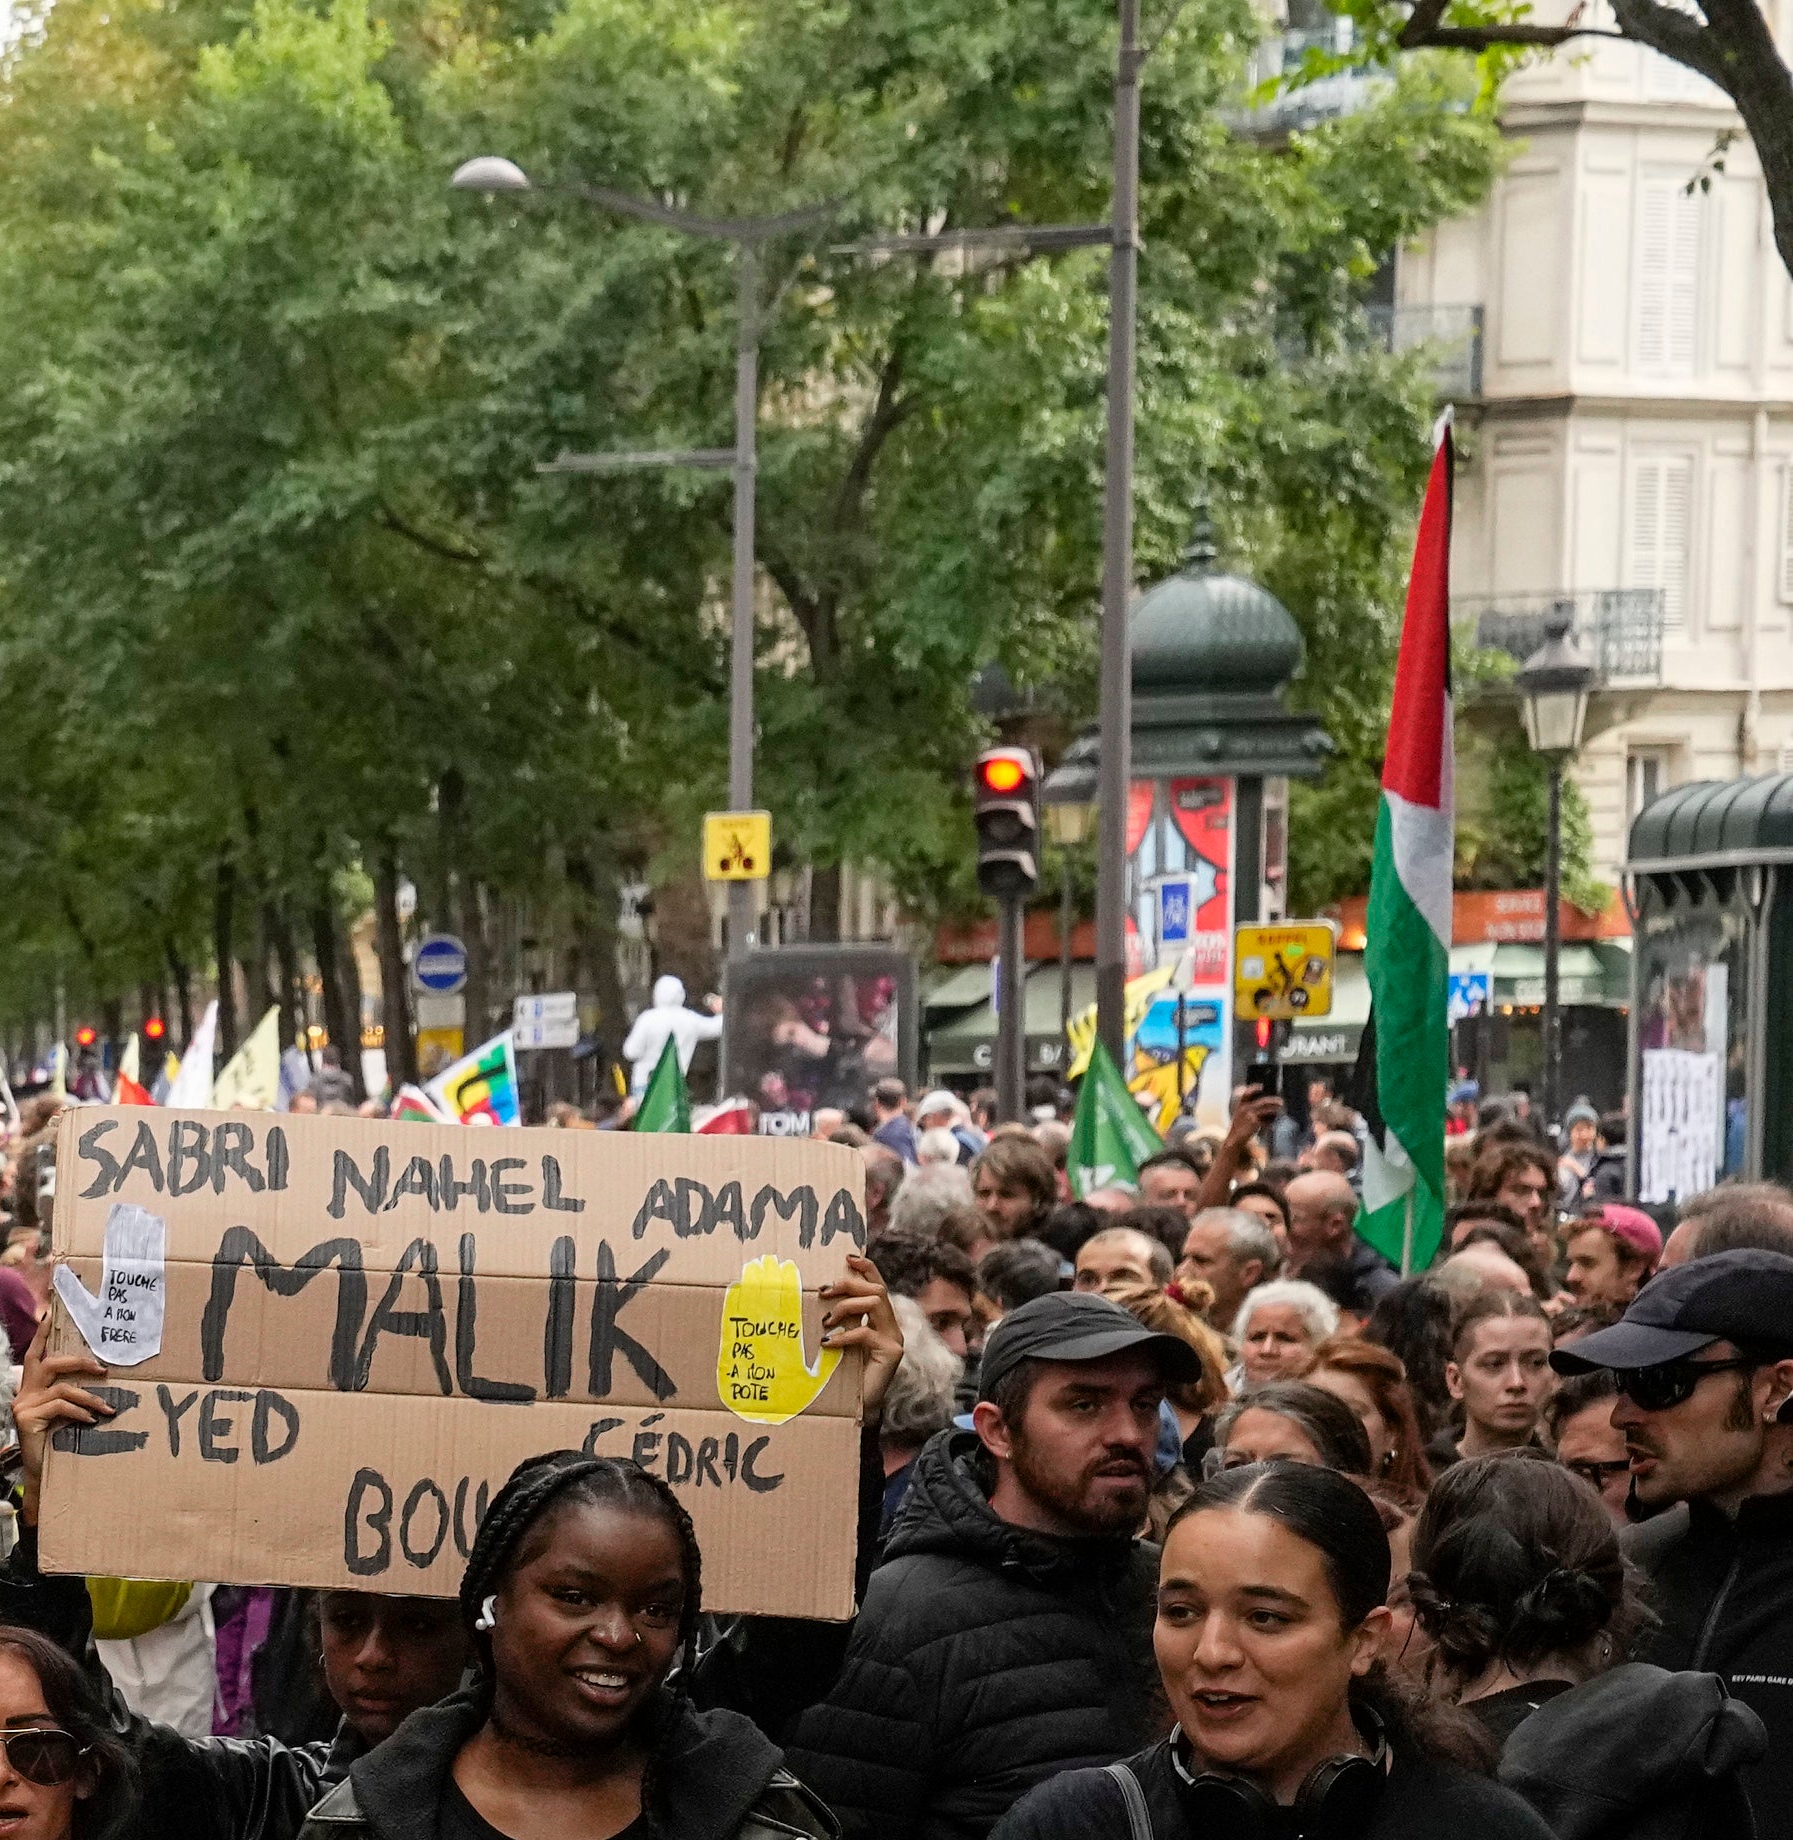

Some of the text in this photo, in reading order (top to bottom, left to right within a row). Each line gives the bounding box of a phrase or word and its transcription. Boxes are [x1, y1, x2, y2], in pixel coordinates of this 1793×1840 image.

[78, 1119, 289, 1198] SABRI
[326, 1145, 586, 1218] NAHEL
[631, 1177, 866, 1249] ADAMA
[108, 1286, 128, 1303] PAS
[110, 1269, 158, 1291] TOUCHE
[200, 1224, 676, 1407] MALIK
[732, 1342, 755, 1360] PAS
[731, 1383, 769, 1401] POTE
